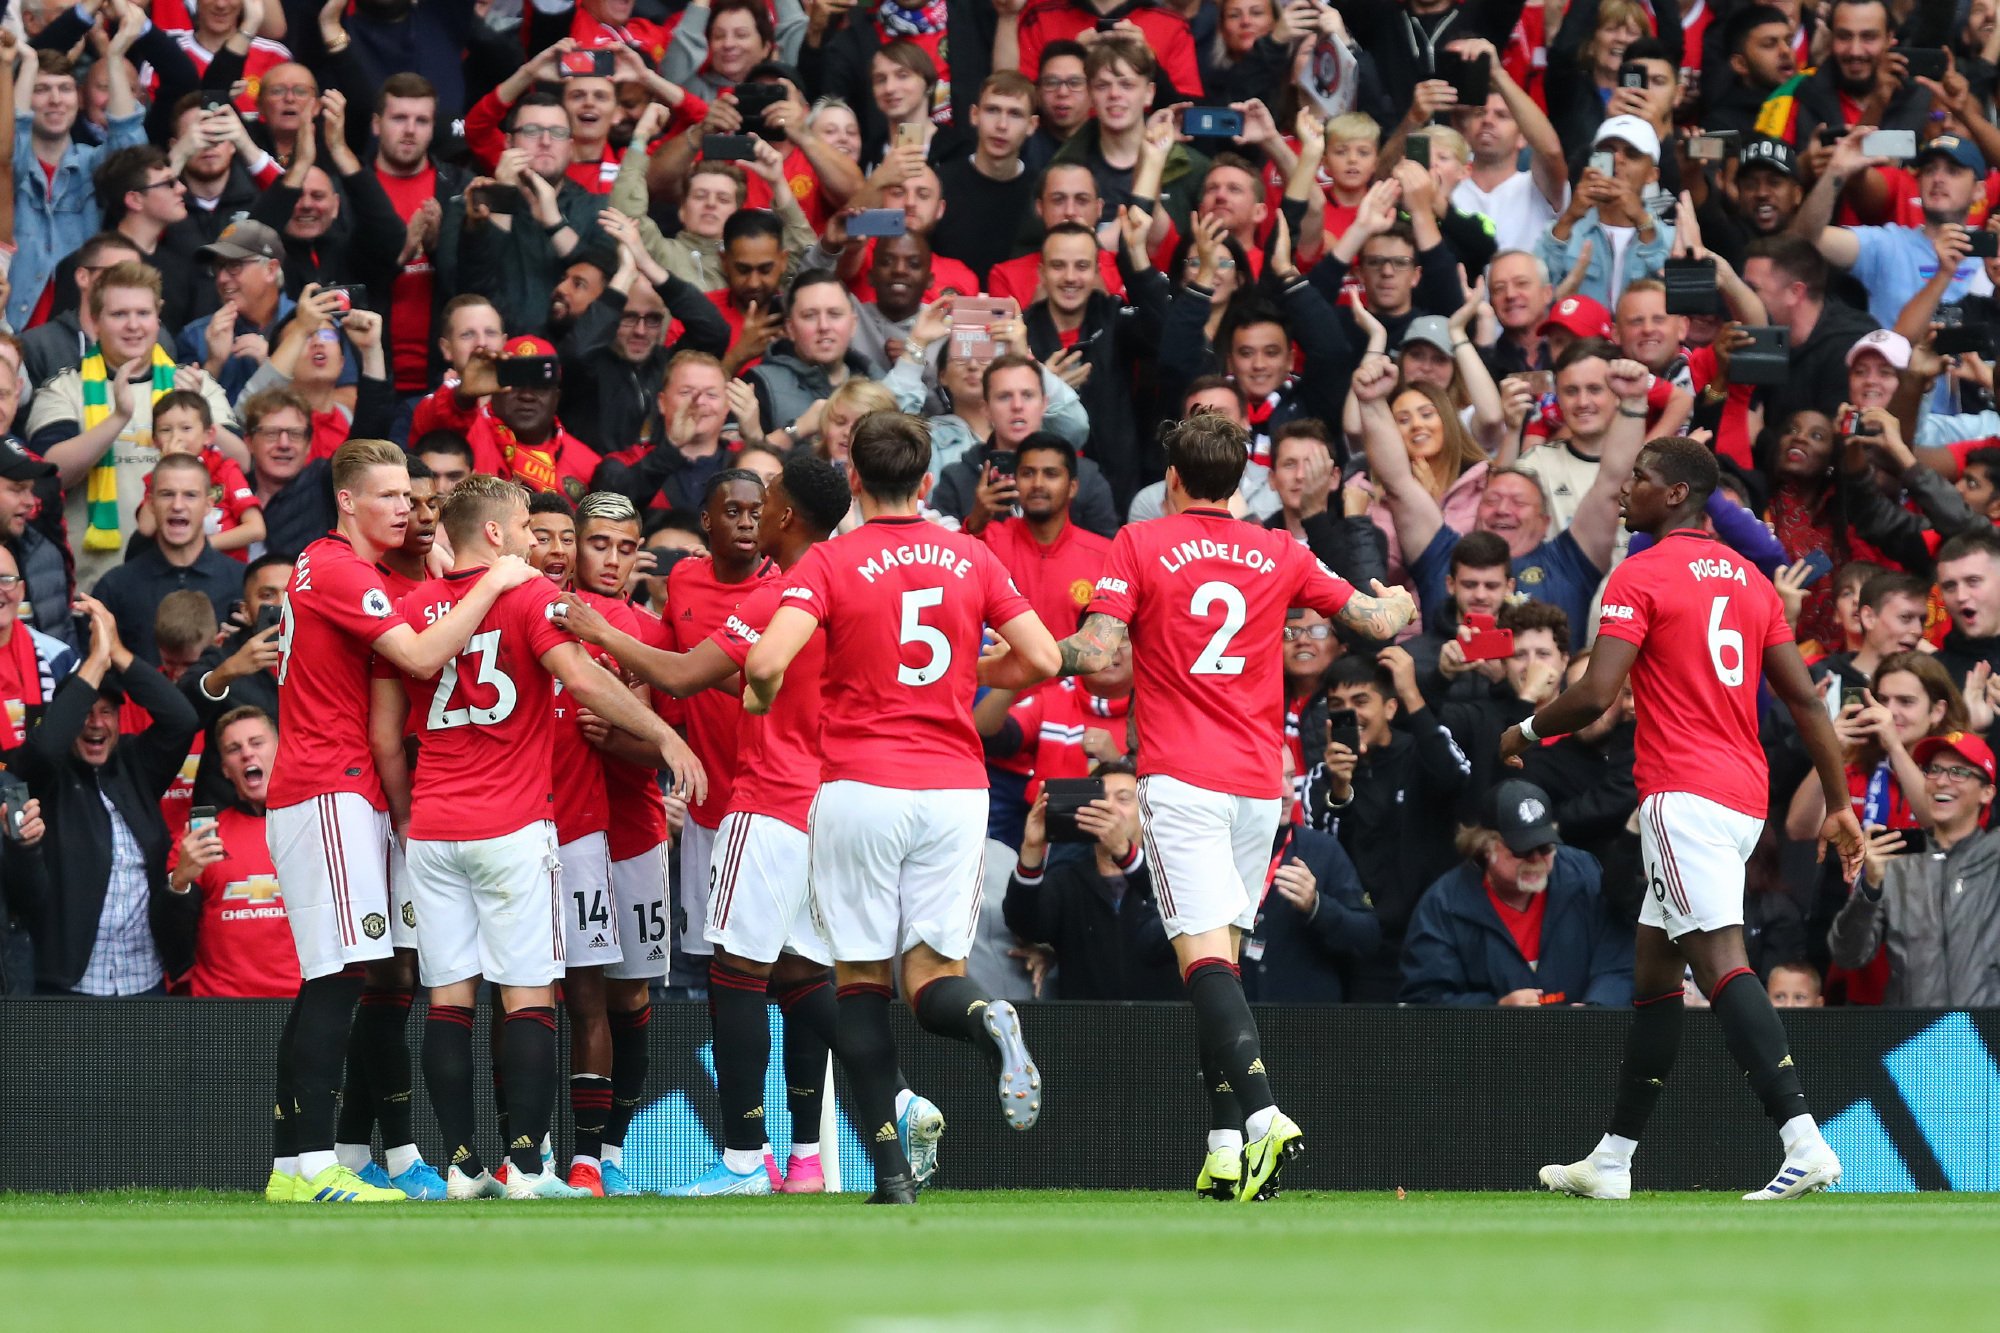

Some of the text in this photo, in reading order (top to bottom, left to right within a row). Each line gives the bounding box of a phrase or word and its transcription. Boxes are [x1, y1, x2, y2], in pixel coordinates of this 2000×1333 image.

[1740, 140, 1788, 164] ICON
[857, 543, 973, 583] MAGUIRE
[1159, 539, 1276, 574] LINDELOF
[1688, 558, 1748, 587] POGBA
[424, 599, 462, 625] SH
[1189, 580, 1247, 675] 2
[1600, 604, 1634, 620] HLER
[897, 586, 952, 687] 5
[1708, 596, 1745, 687] 6
[426, 629, 518, 731] 23
[1651, 862, 1666, 902] 6
[573, 890, 609, 930] 14
[633, 900, 666, 944] 15
[876, 1132, 898, 1142] adidas
